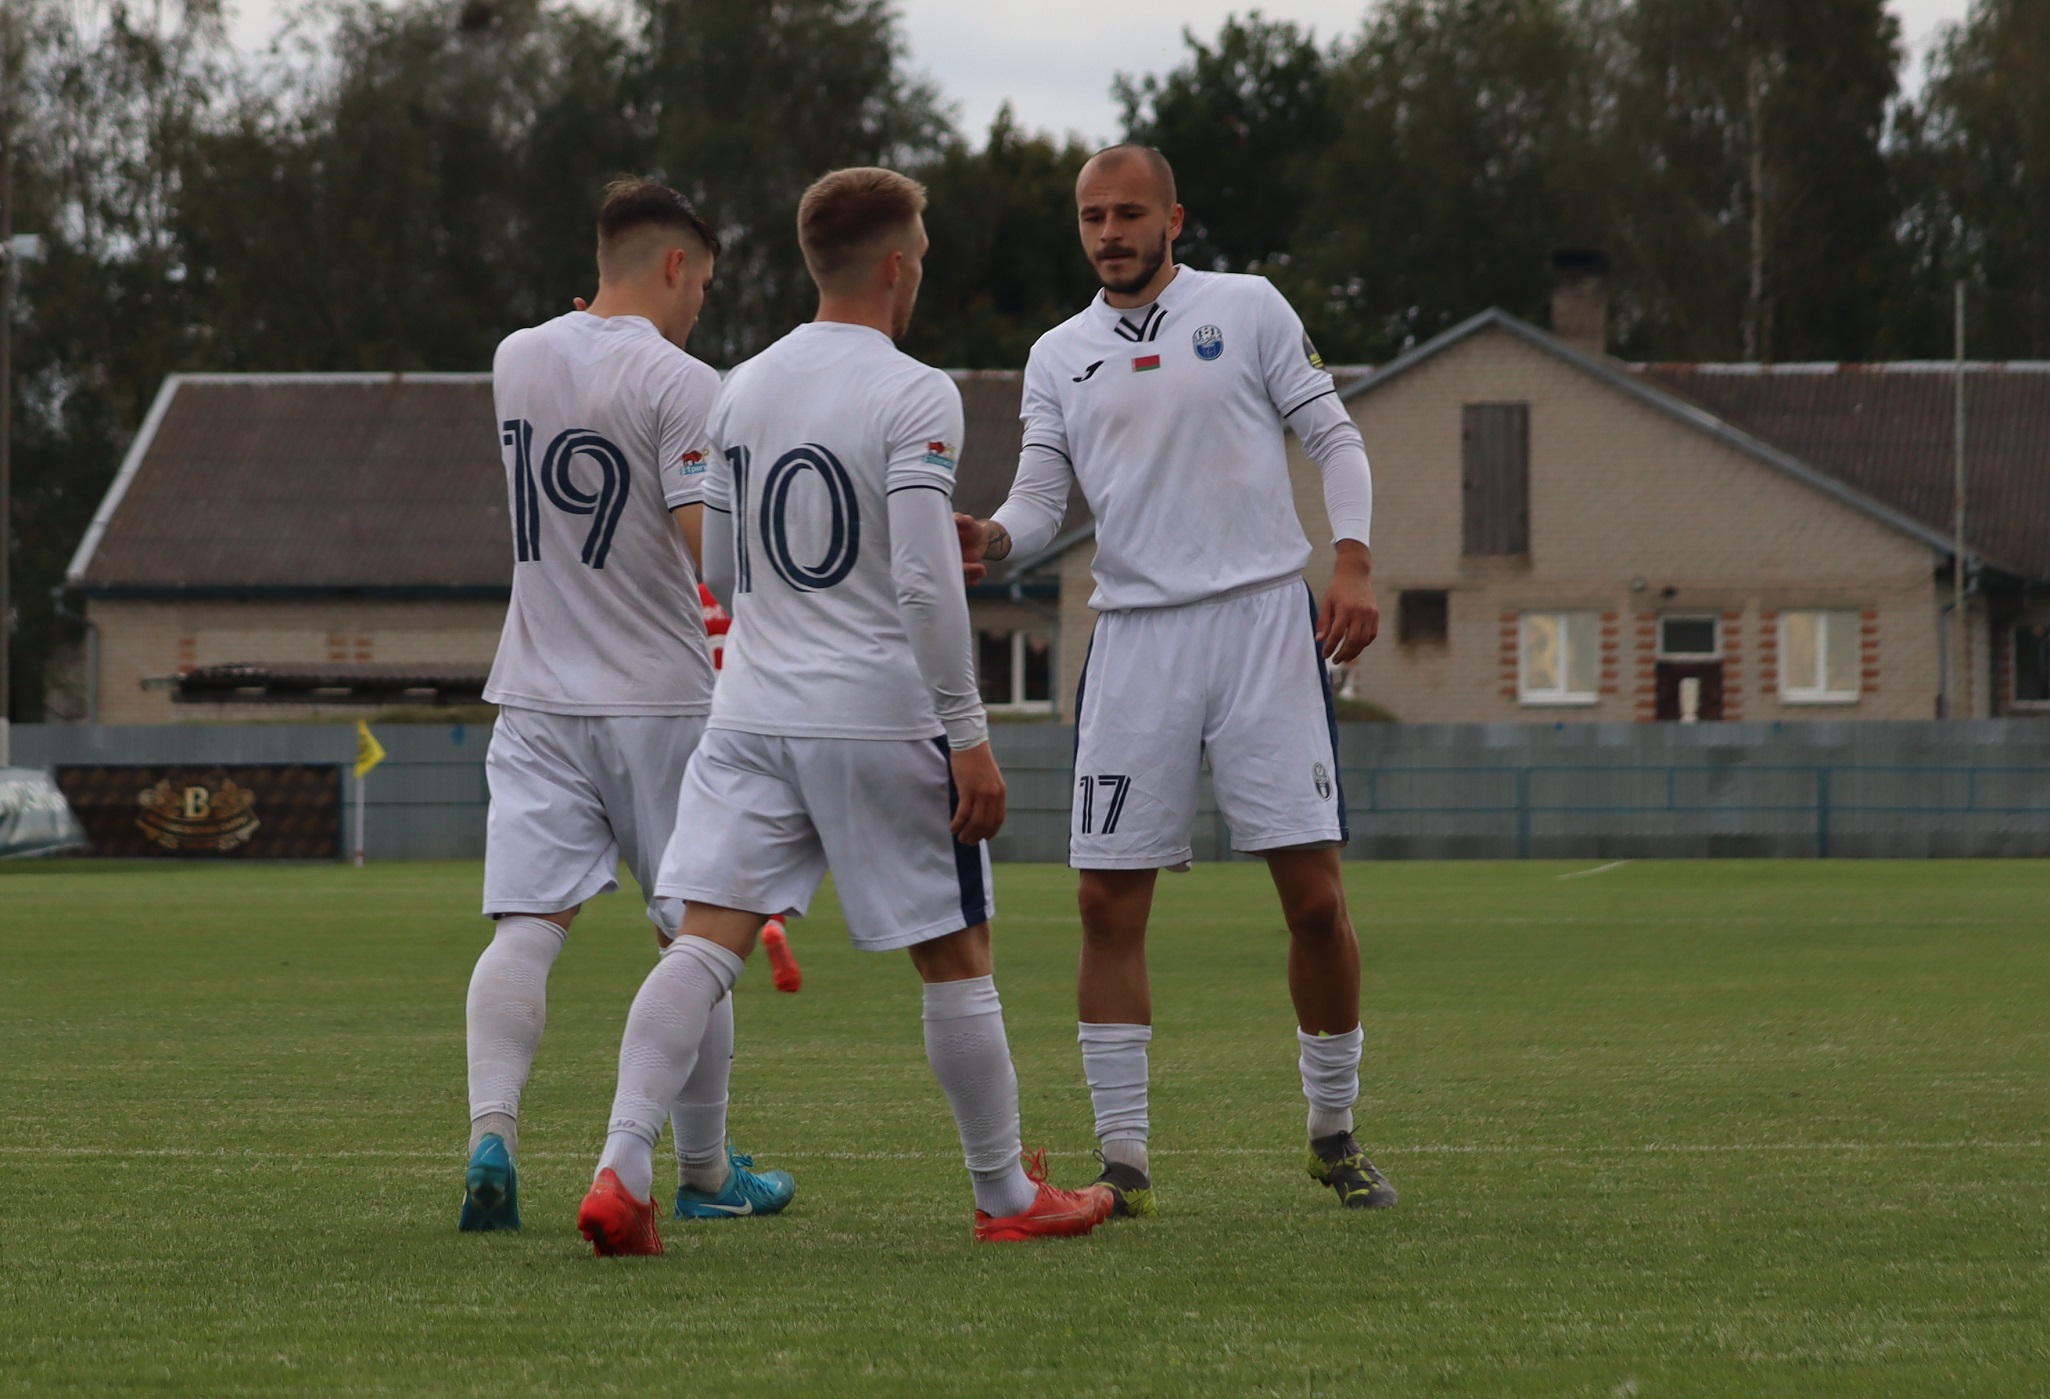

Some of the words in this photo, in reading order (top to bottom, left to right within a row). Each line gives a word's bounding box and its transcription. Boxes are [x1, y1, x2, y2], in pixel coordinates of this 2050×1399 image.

[503, 419, 631, 569] 19
[724, 443, 860, 593] 10
[184, 786, 211, 818] B
[1079, 775, 1131, 834] 17
